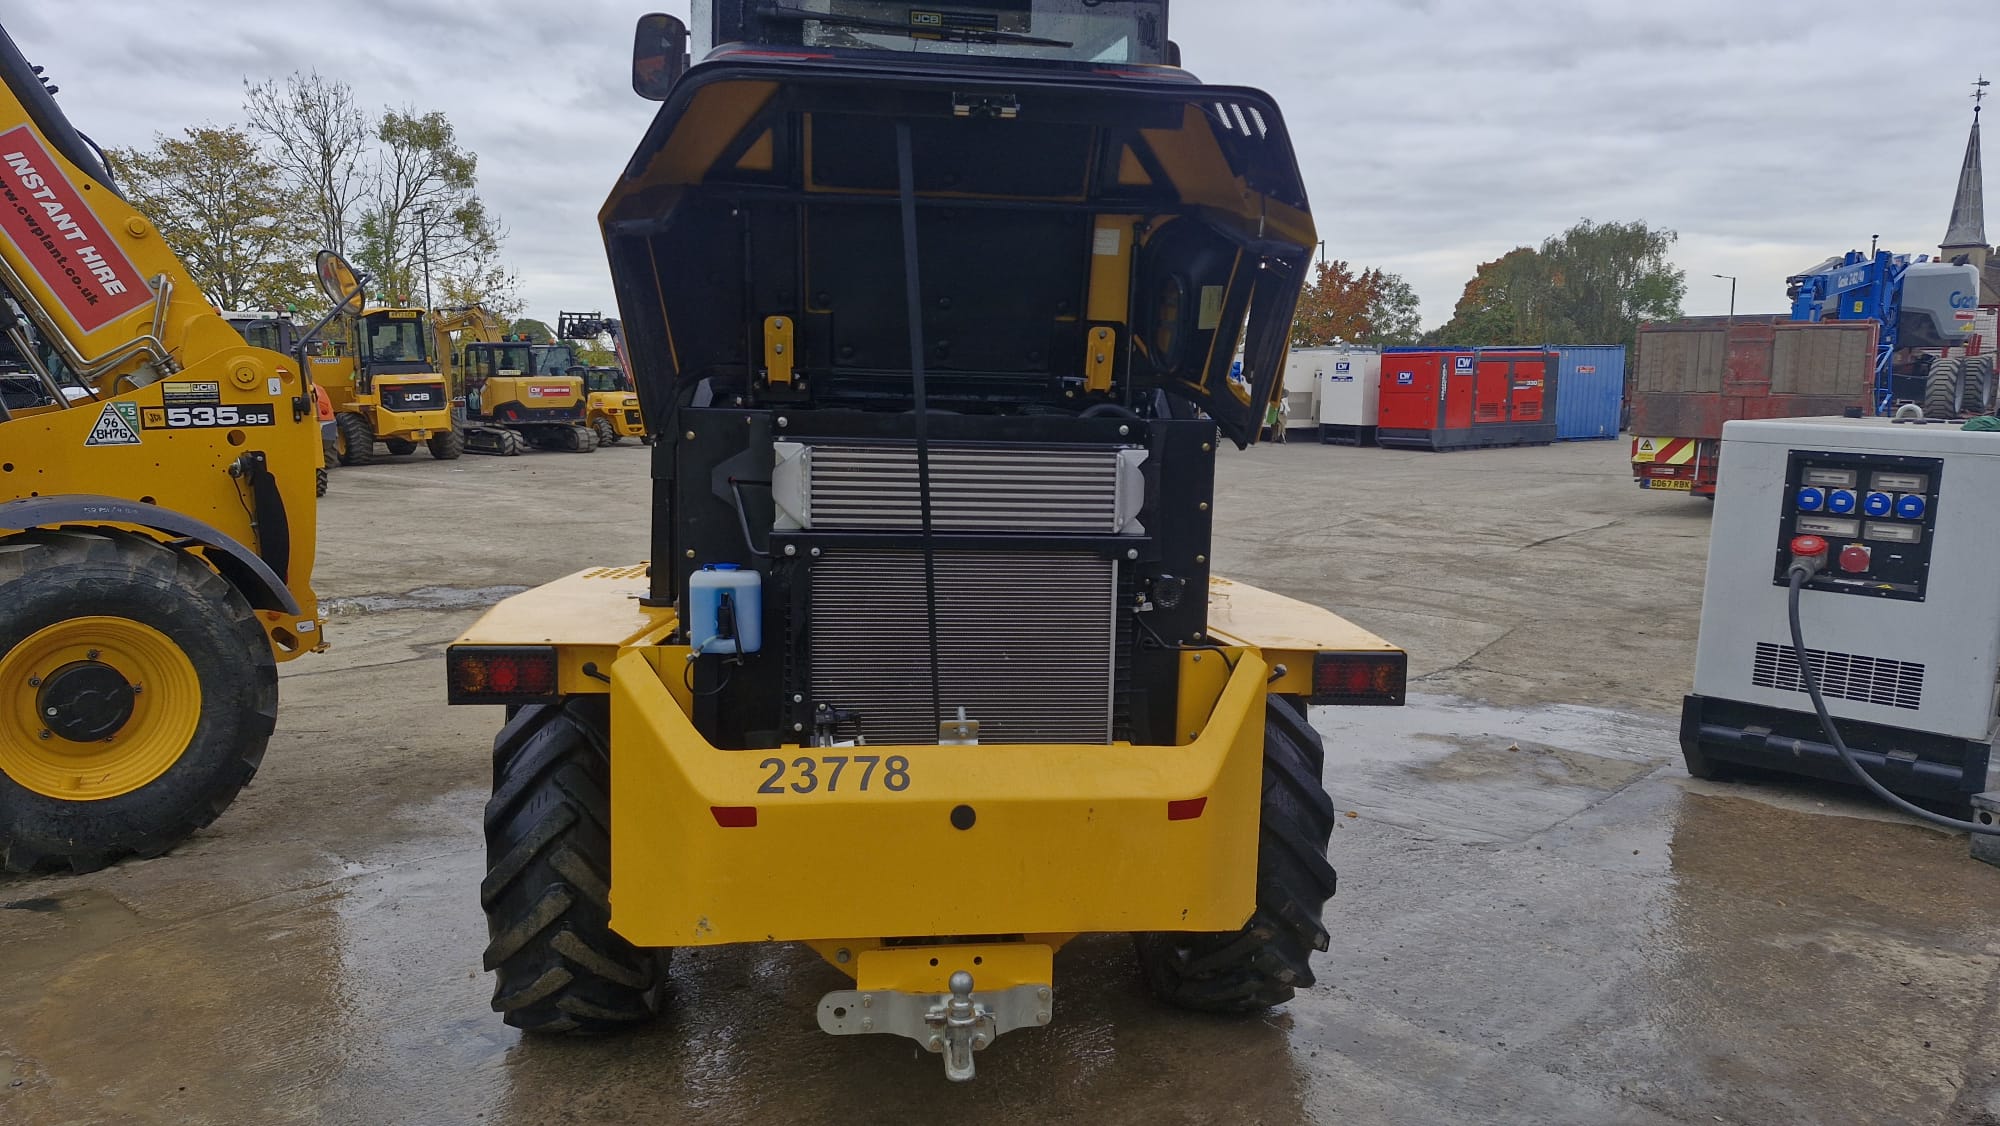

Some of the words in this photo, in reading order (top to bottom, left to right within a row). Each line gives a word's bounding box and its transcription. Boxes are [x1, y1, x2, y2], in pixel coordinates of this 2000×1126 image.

[914, 14, 939, 24] JCB
[3, 151, 88, 241] INSTANT
[76, 245, 127, 297] HIRE
[1457, 357, 1472, 368] CW
[405, 393, 430, 401] JCB
[127, 407, 136, 416] 5
[103, 418, 118, 428] 96
[96, 428, 128, 440] BH7G
[757, 755, 911, 795] 23778
